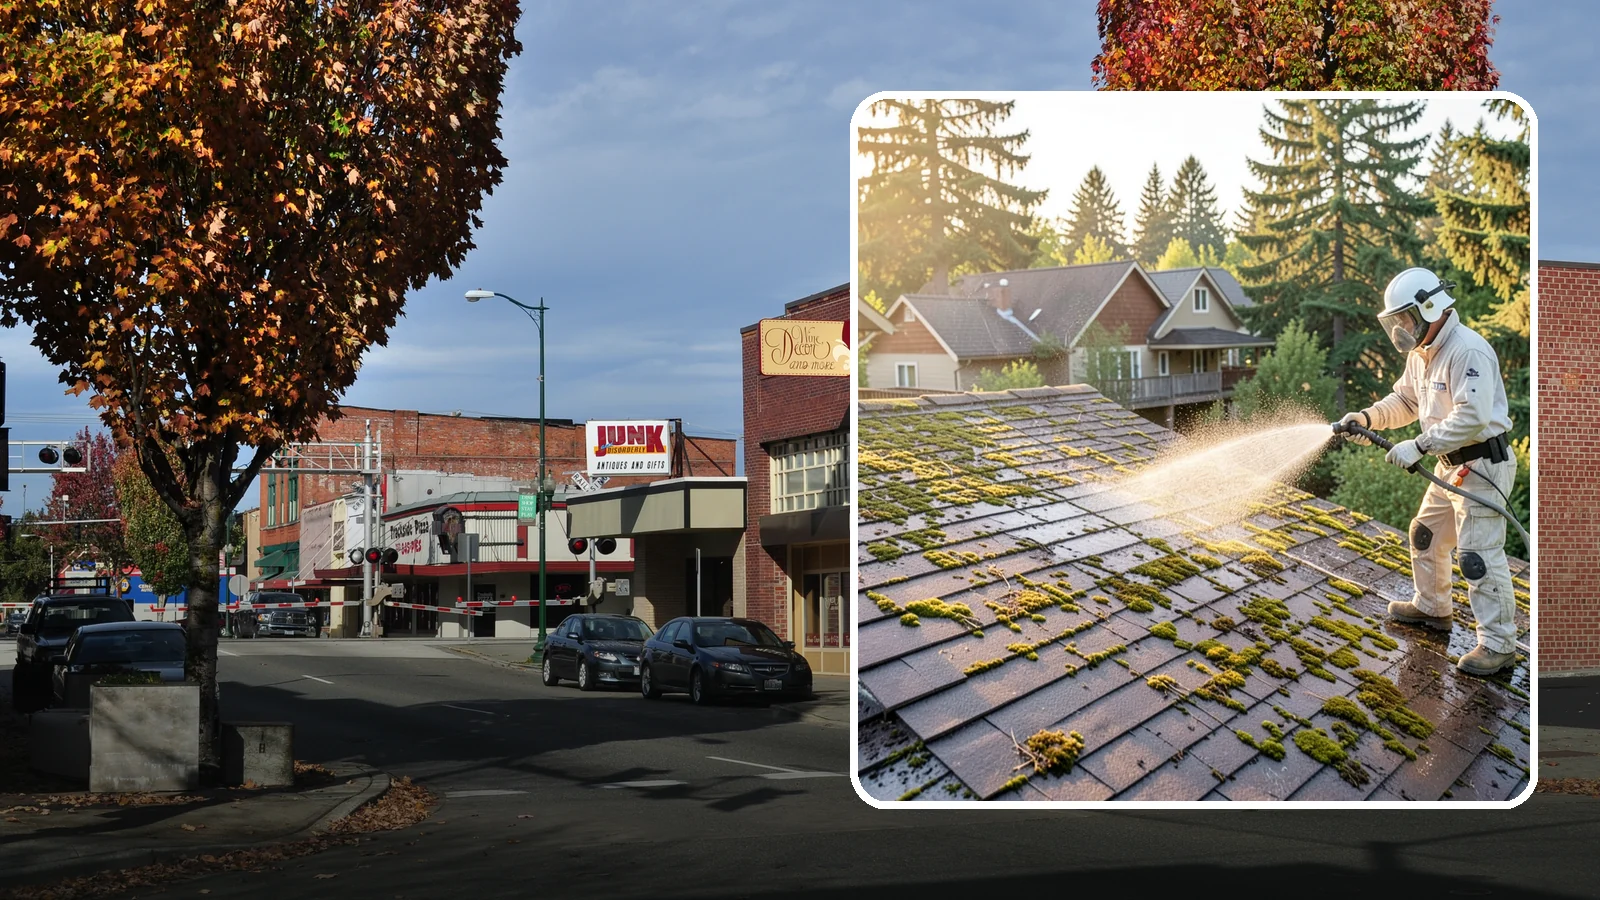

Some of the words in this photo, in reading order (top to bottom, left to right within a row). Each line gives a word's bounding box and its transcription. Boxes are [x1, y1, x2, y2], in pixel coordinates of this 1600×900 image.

[595, 425, 665, 457] JUNK
[607, 446, 646, 454] DISORDERLY
[597, 461, 628, 470] ANTIQUES
[631, 461, 644, 470] AND
[647, 460, 665, 469] GIFTS
[414, 520, 429, 535] Pizza
